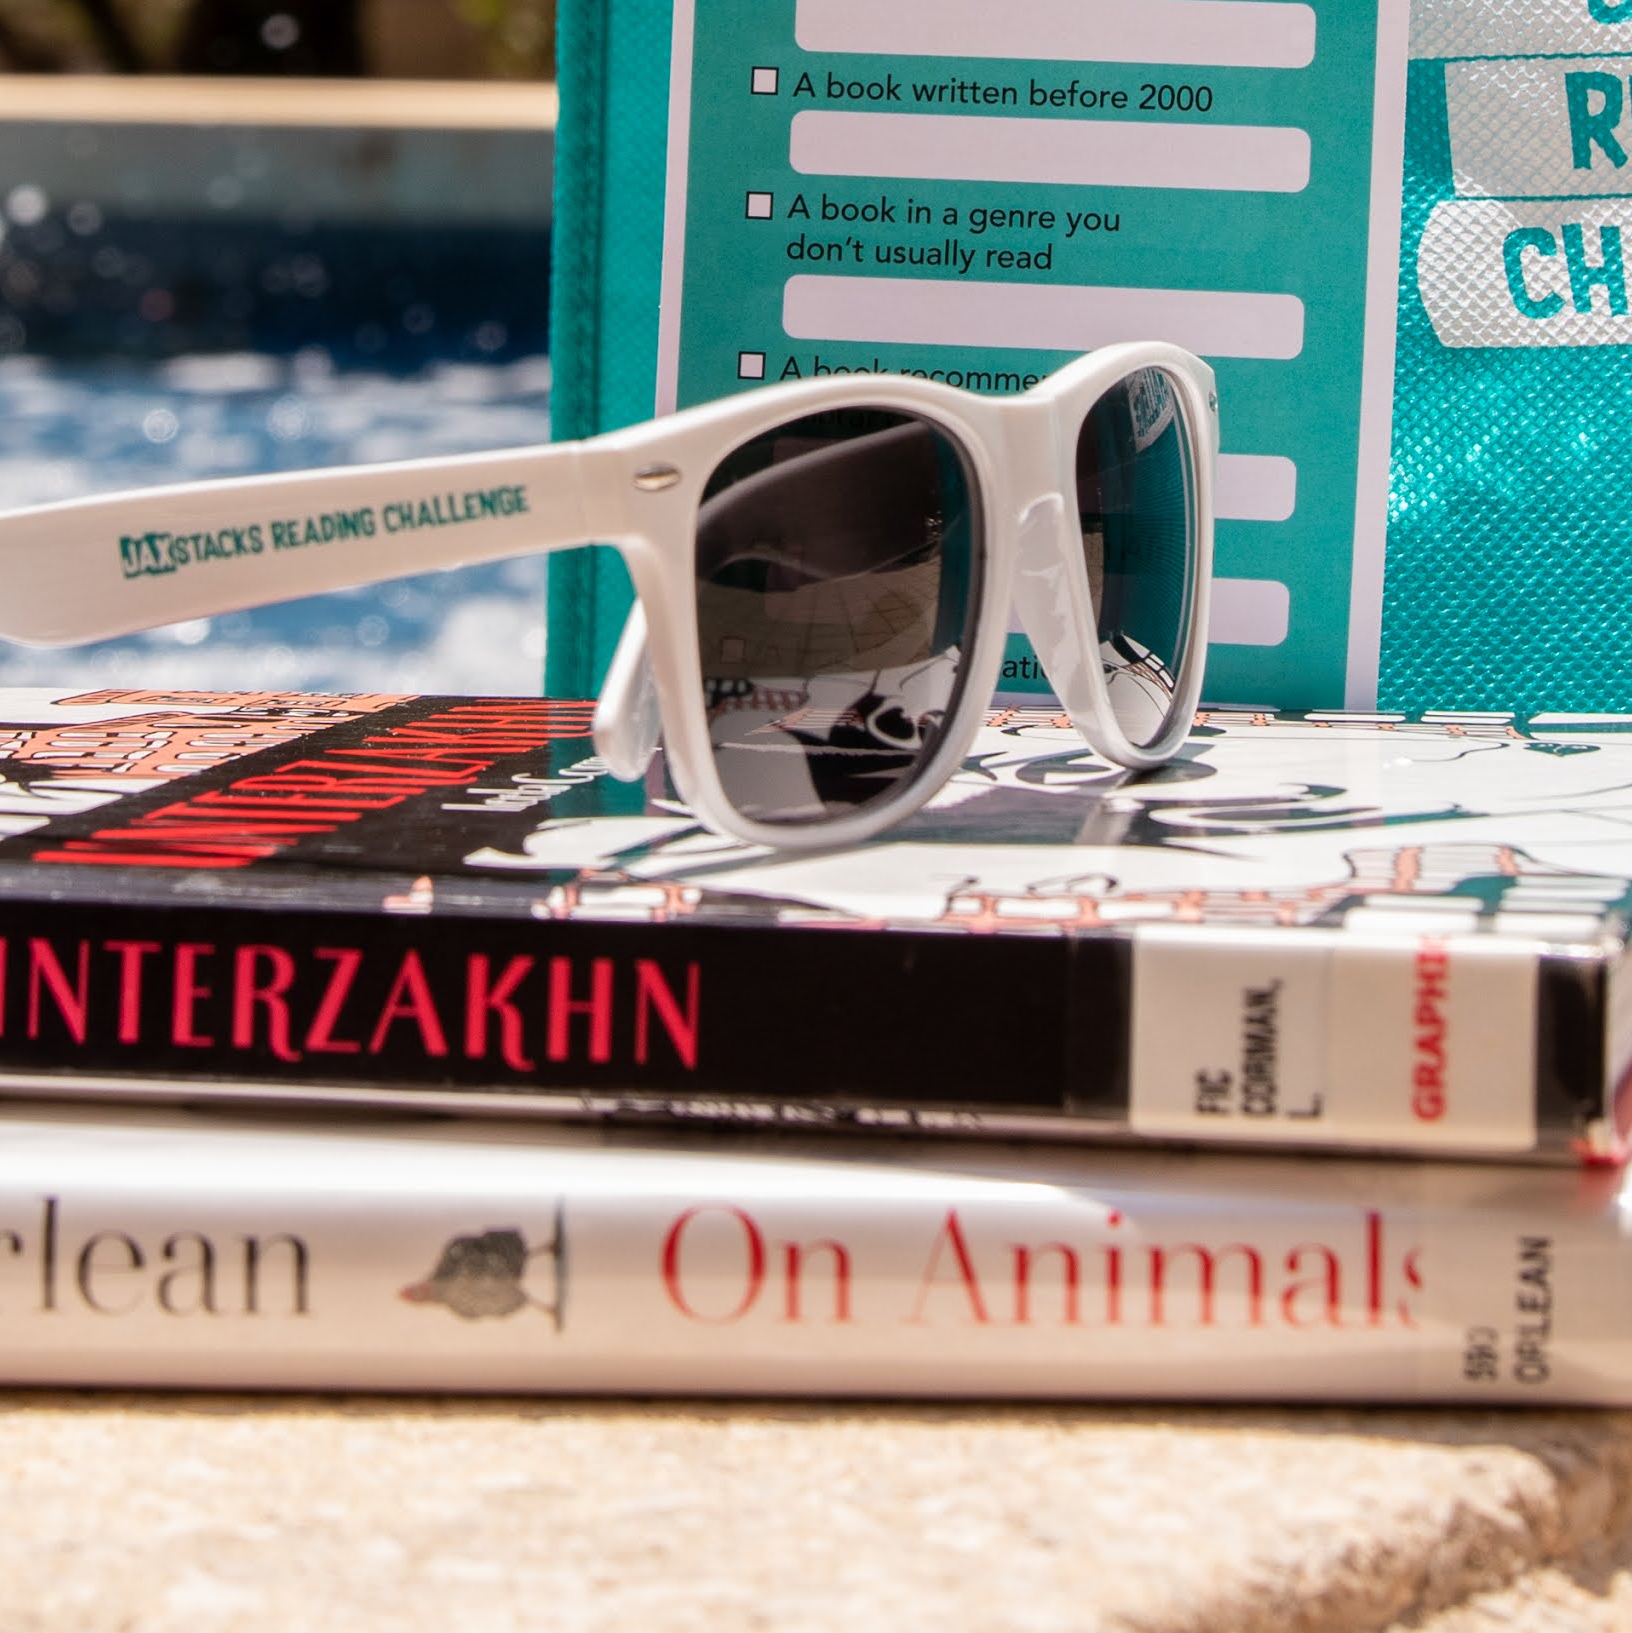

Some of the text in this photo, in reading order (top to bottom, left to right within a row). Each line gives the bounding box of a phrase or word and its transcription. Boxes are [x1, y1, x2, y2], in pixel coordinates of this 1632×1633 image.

[792, 71, 1214, 112] A book written before 2000
[787, 193, 1121, 238] A book in a genre you
[786, 233, 1053, 275] don't usually read
[779, 355, 802, 381] A
[171, 524, 265, 565] STACKS
[382, 483, 531, 535] CHALLENGE
[1194, 1068, 1233, 1118] FIC
[658, 1201, 861, 1327] On
[1513, 1235, 1553, 1384] ORLEAN
